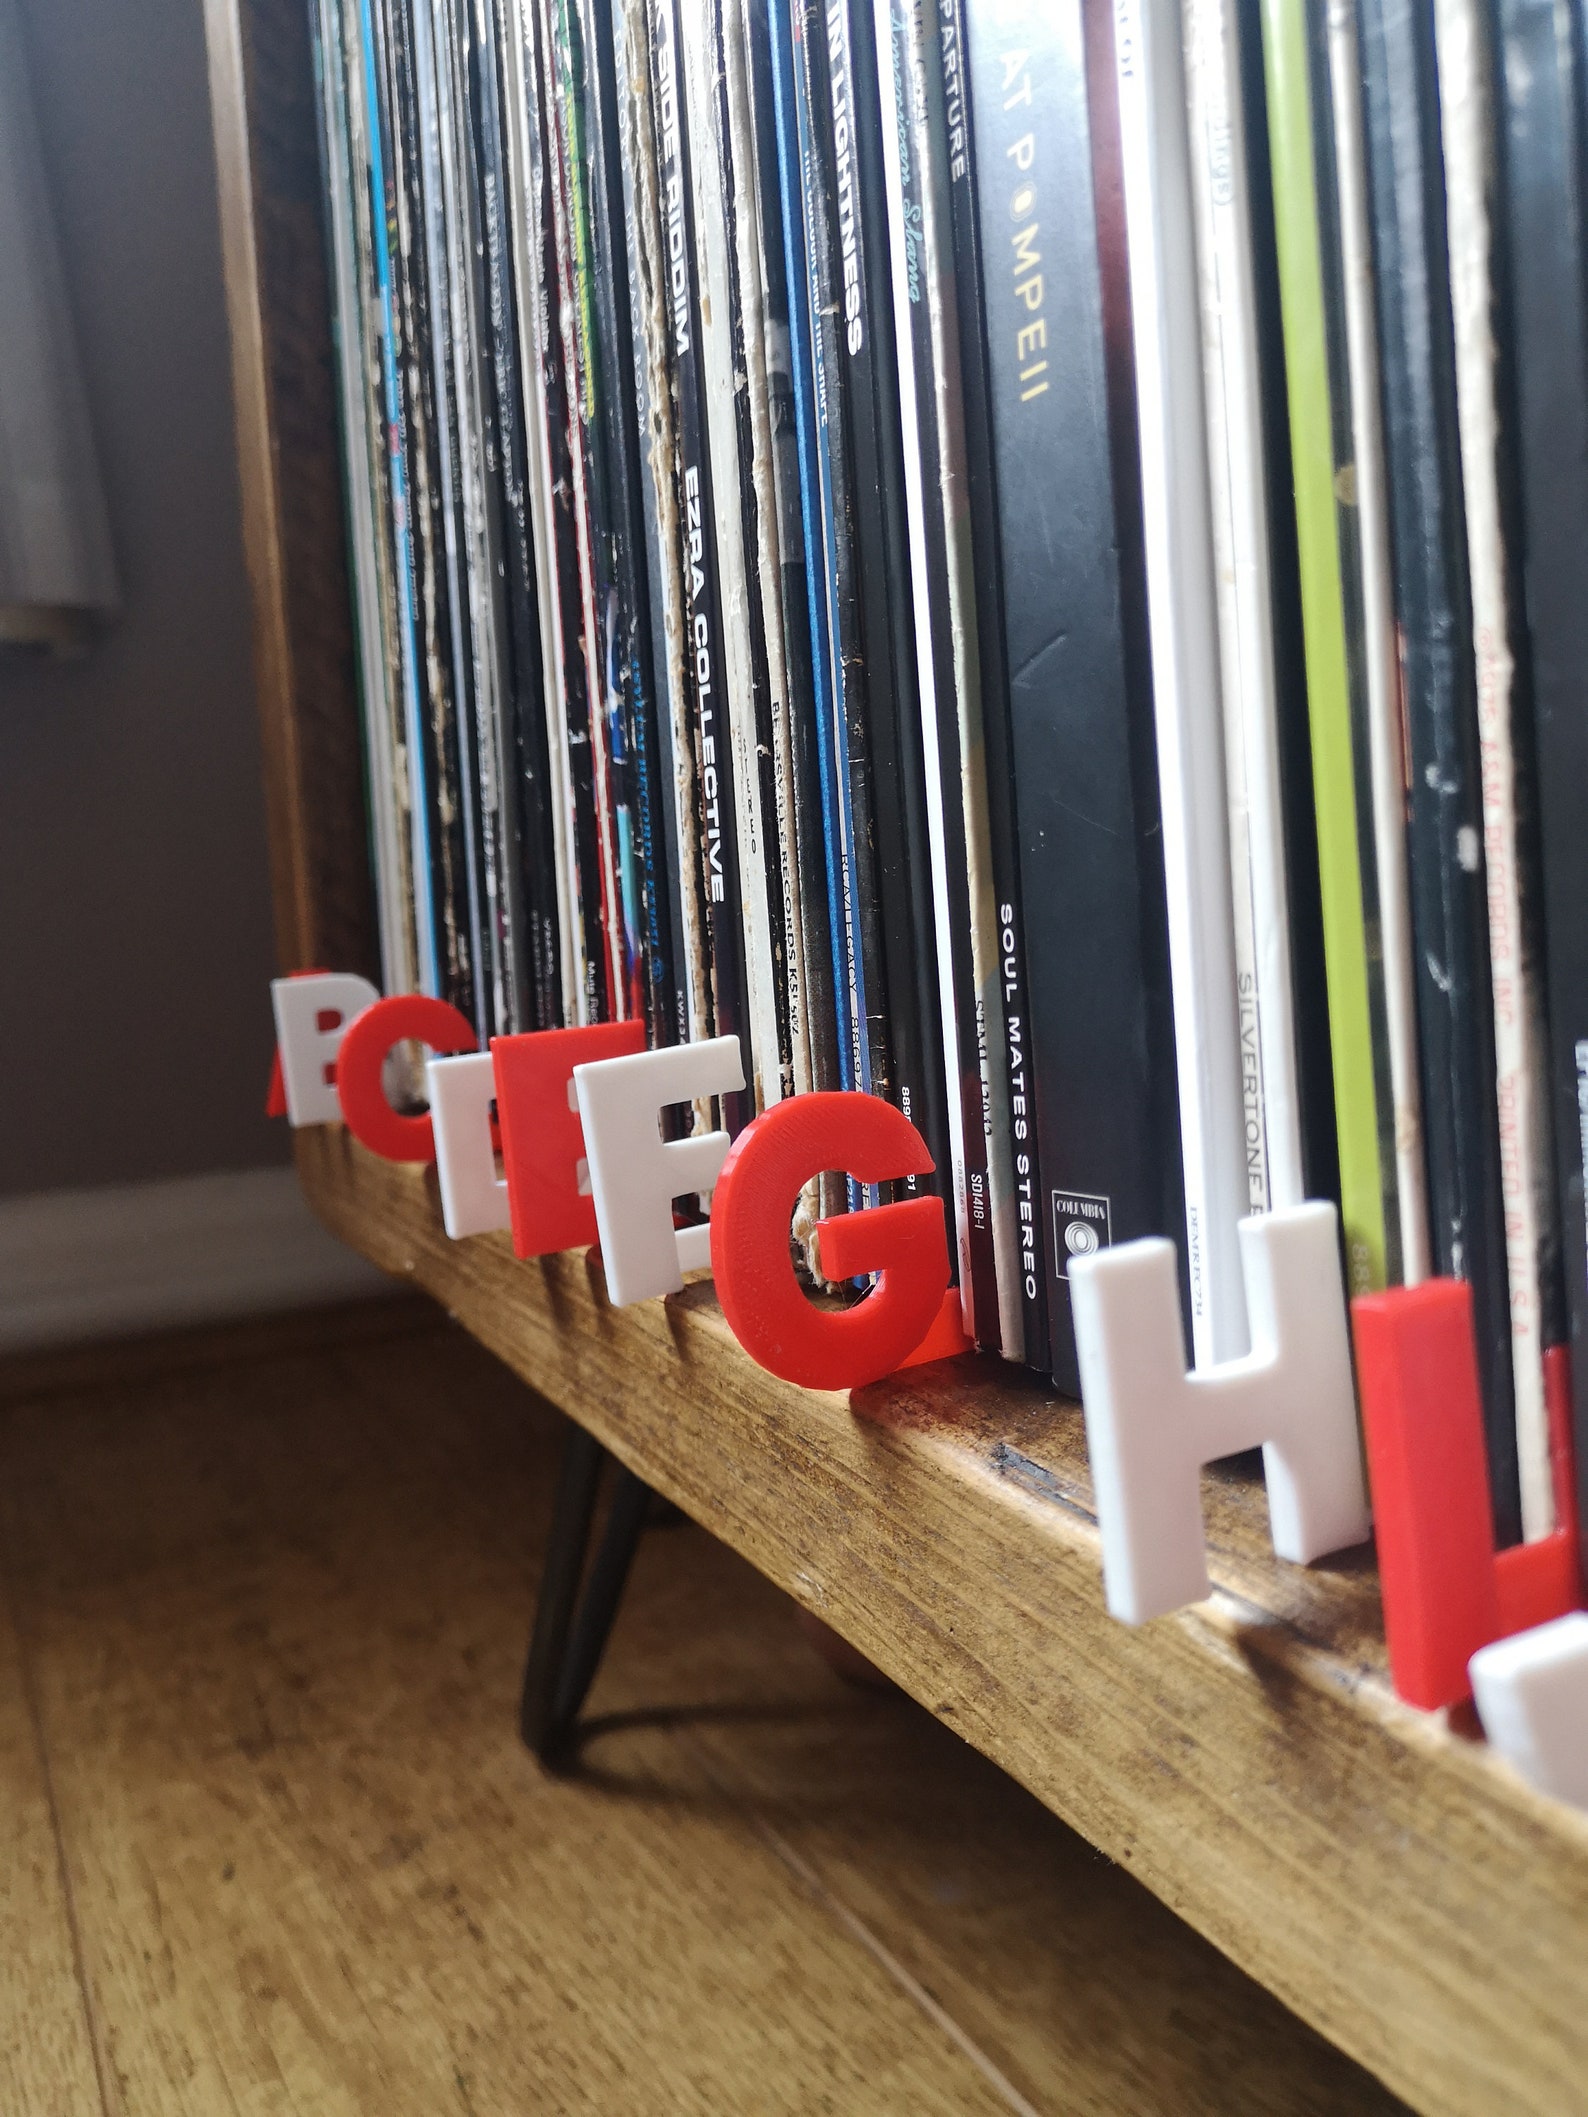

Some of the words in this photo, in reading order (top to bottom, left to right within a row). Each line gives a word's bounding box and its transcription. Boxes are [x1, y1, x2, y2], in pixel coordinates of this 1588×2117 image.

[826, 2, 843, 62] IN
[939, 0, 965, 183] PARTURE
[999, 49, 1032, 111] AT
[613, 28, 628, 171] EDITORS
[658, 49, 675, 163] SIDE
[890, 8, 909, 185] American
[902, 198, 921, 302] Slang
[666, 174, 690, 356] RIDDIM
[831, 68, 863, 355] LIGHTNESS
[1006, 133, 1049, 402] POMPEII
[628, 269, 639, 340] BACK
[633, 353, 645, 437] ROOM
[684, 466, 705, 600] EZRA
[696, 613, 725, 902] COLLECTIVE
[742, 738, 757, 853] STEREO
[781, 851, 796, 961] RECORDS
[999, 903, 1018, 1001] SOUL
[851, 1016, 862, 1092] 88697
[1006, 1016, 1028, 1140] MATES
[1236, 972, 1262, 1192] SILVERTONE
[1015, 1153, 1037, 1299] STEREO
[1055, 1199, 1106, 1220] COLUMBIA
[271, 973, 384, 1127] B
[337, 995, 478, 1161] C
[491, 1020, 645, 1258] E
[573, 1035, 746, 1307] F
[710, 1091, 952, 1391] G
[1067, 1200, 1372, 1627] H
